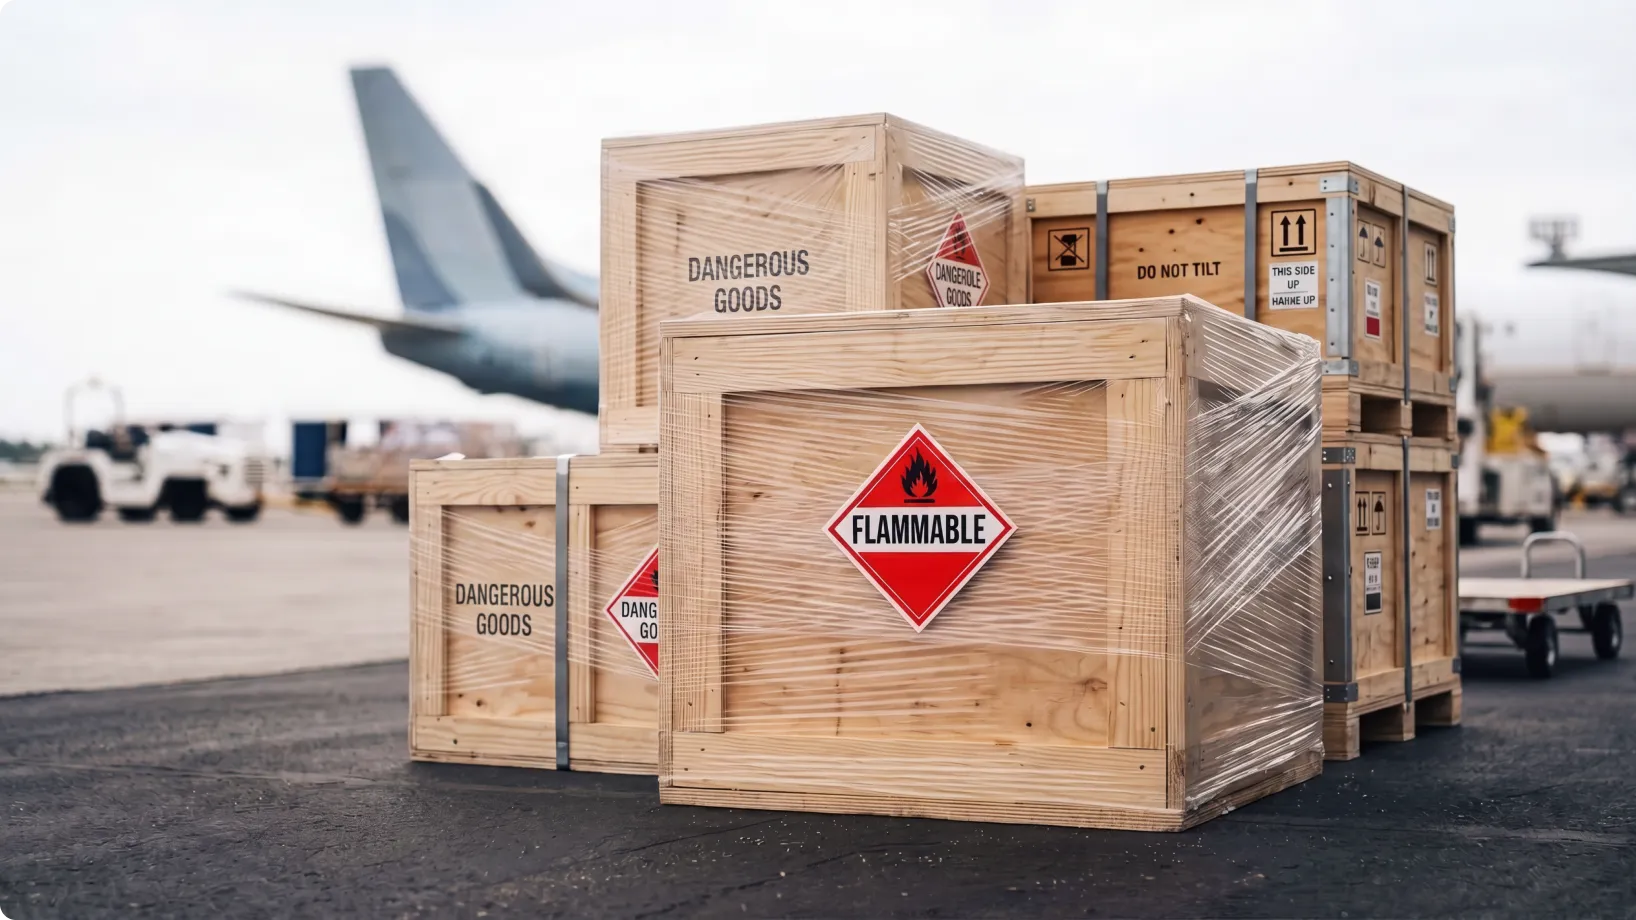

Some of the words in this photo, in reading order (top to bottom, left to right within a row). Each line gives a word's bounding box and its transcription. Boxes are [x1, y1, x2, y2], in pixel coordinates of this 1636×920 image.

[688, 249, 810, 282] DANGEROUS
[1137, 265, 1157, 280] DO
[1160, 263, 1189, 279] NOT
[1192, 261, 1221, 277] TILT
[1272, 266, 1292, 277] THIS
[1294, 265, 1315, 276] SIDE
[1287, 279, 1300, 290] UP
[714, 284, 782, 314] GOODS
[946, 287, 972, 307] GOODS
[1303, 295, 1316, 305] UP
[852, 514, 986, 545] FLAMMABLE
[455, 583, 554, 607] DANGEROUS
[476, 612, 532, 637] GOODS
